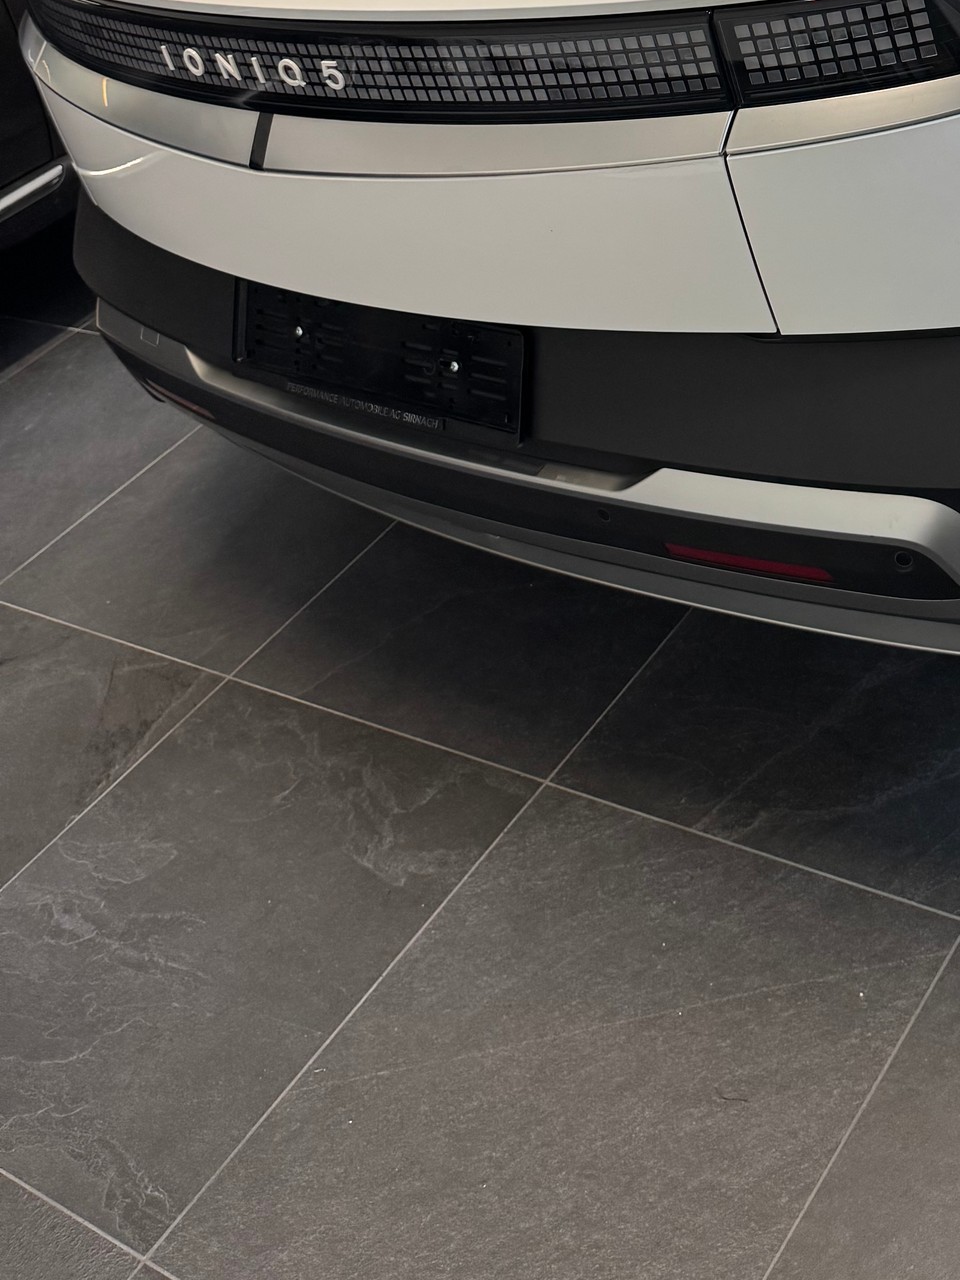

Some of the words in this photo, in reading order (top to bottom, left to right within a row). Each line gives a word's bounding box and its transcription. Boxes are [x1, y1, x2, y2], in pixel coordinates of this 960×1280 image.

[160, 44, 307, 88] IONIQ
[319, 59, 346, 91] 5
[286, 381, 339, 404] PERFORMANCE
[340, 395, 388, 417] AUTOMOBILE
[390, 408, 401, 420] AG
[402, 411, 440, 429] SIRNACH
